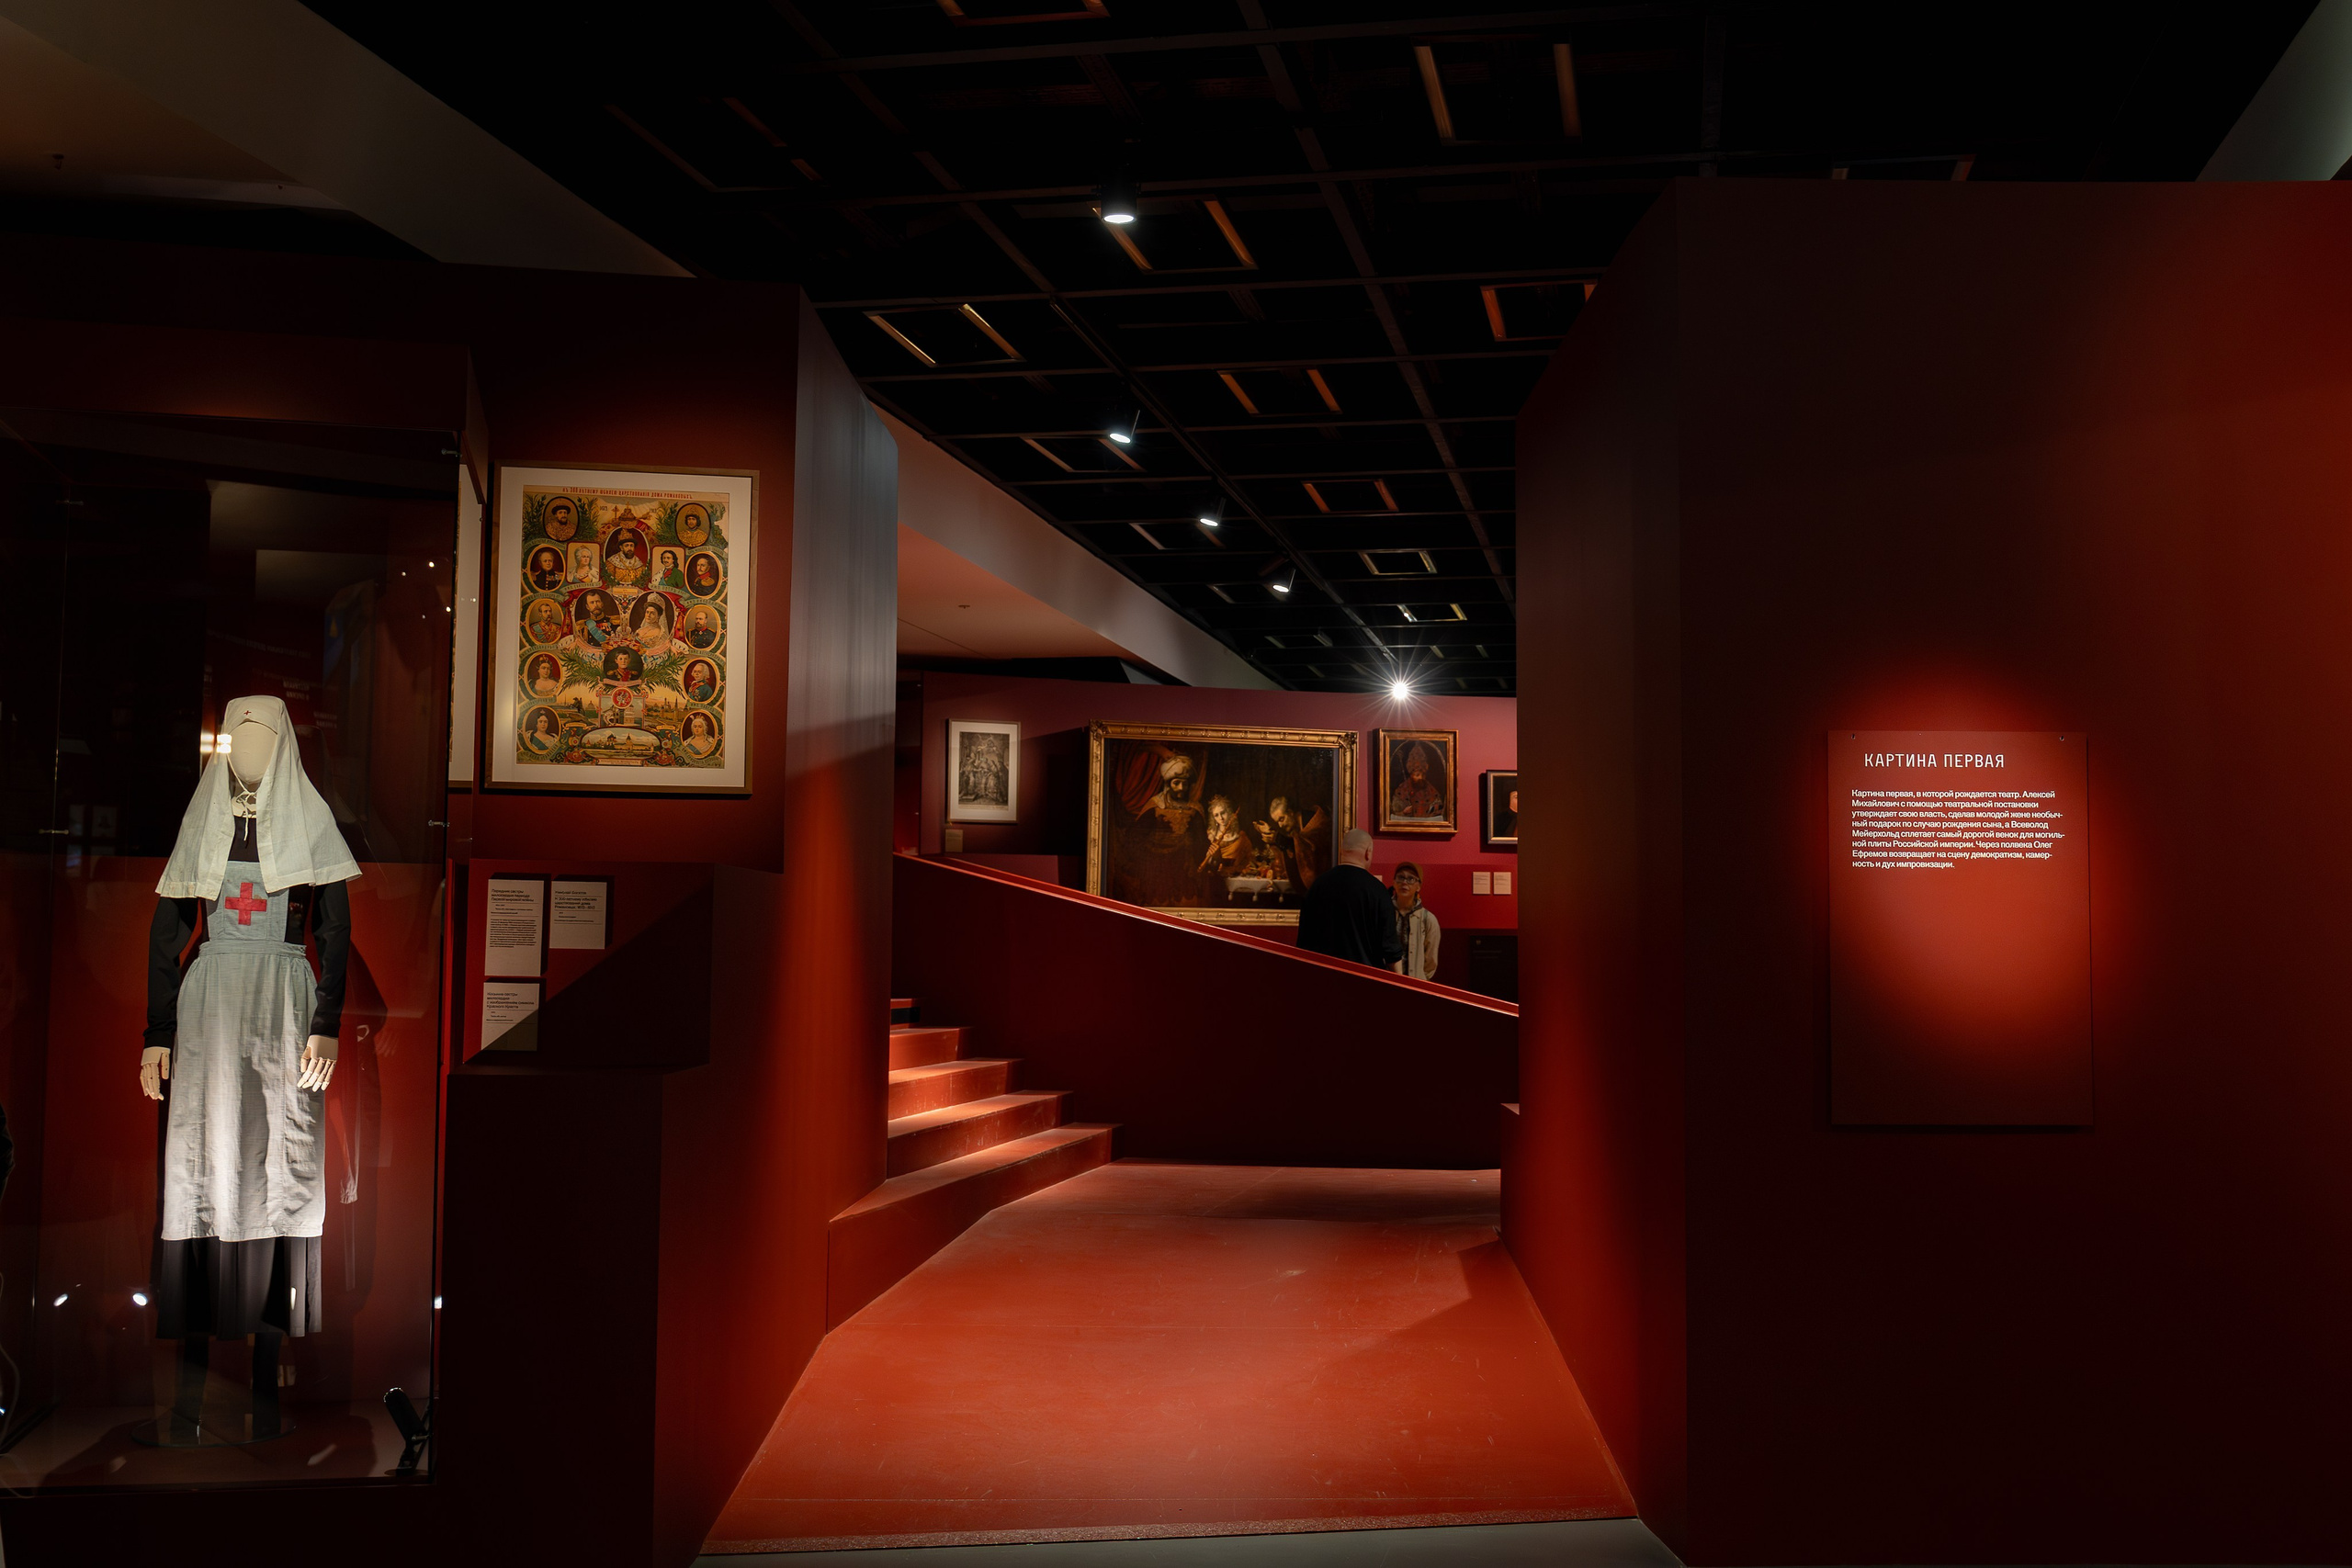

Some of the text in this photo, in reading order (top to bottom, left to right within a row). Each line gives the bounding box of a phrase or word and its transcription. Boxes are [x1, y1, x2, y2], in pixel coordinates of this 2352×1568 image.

[1864, 753, 2004, 768] КАРТИНА ПЕРВАЯ
[1852, 790, 1885, 799] Картина
[1922, 790, 1953, 799] которой
[1943, 800, 1993, 809] театральной
[1976, 811, 2009, 819] молодой
[2011, 821, 2049, 829] Всеволод
[1852, 830, 1900, 839] Мейерхольд
[1962, 831, 1994, 839] дорогой
[1975, 841, 1999, 849] Через
[1852, 850, 1888, 859] Ефремов
